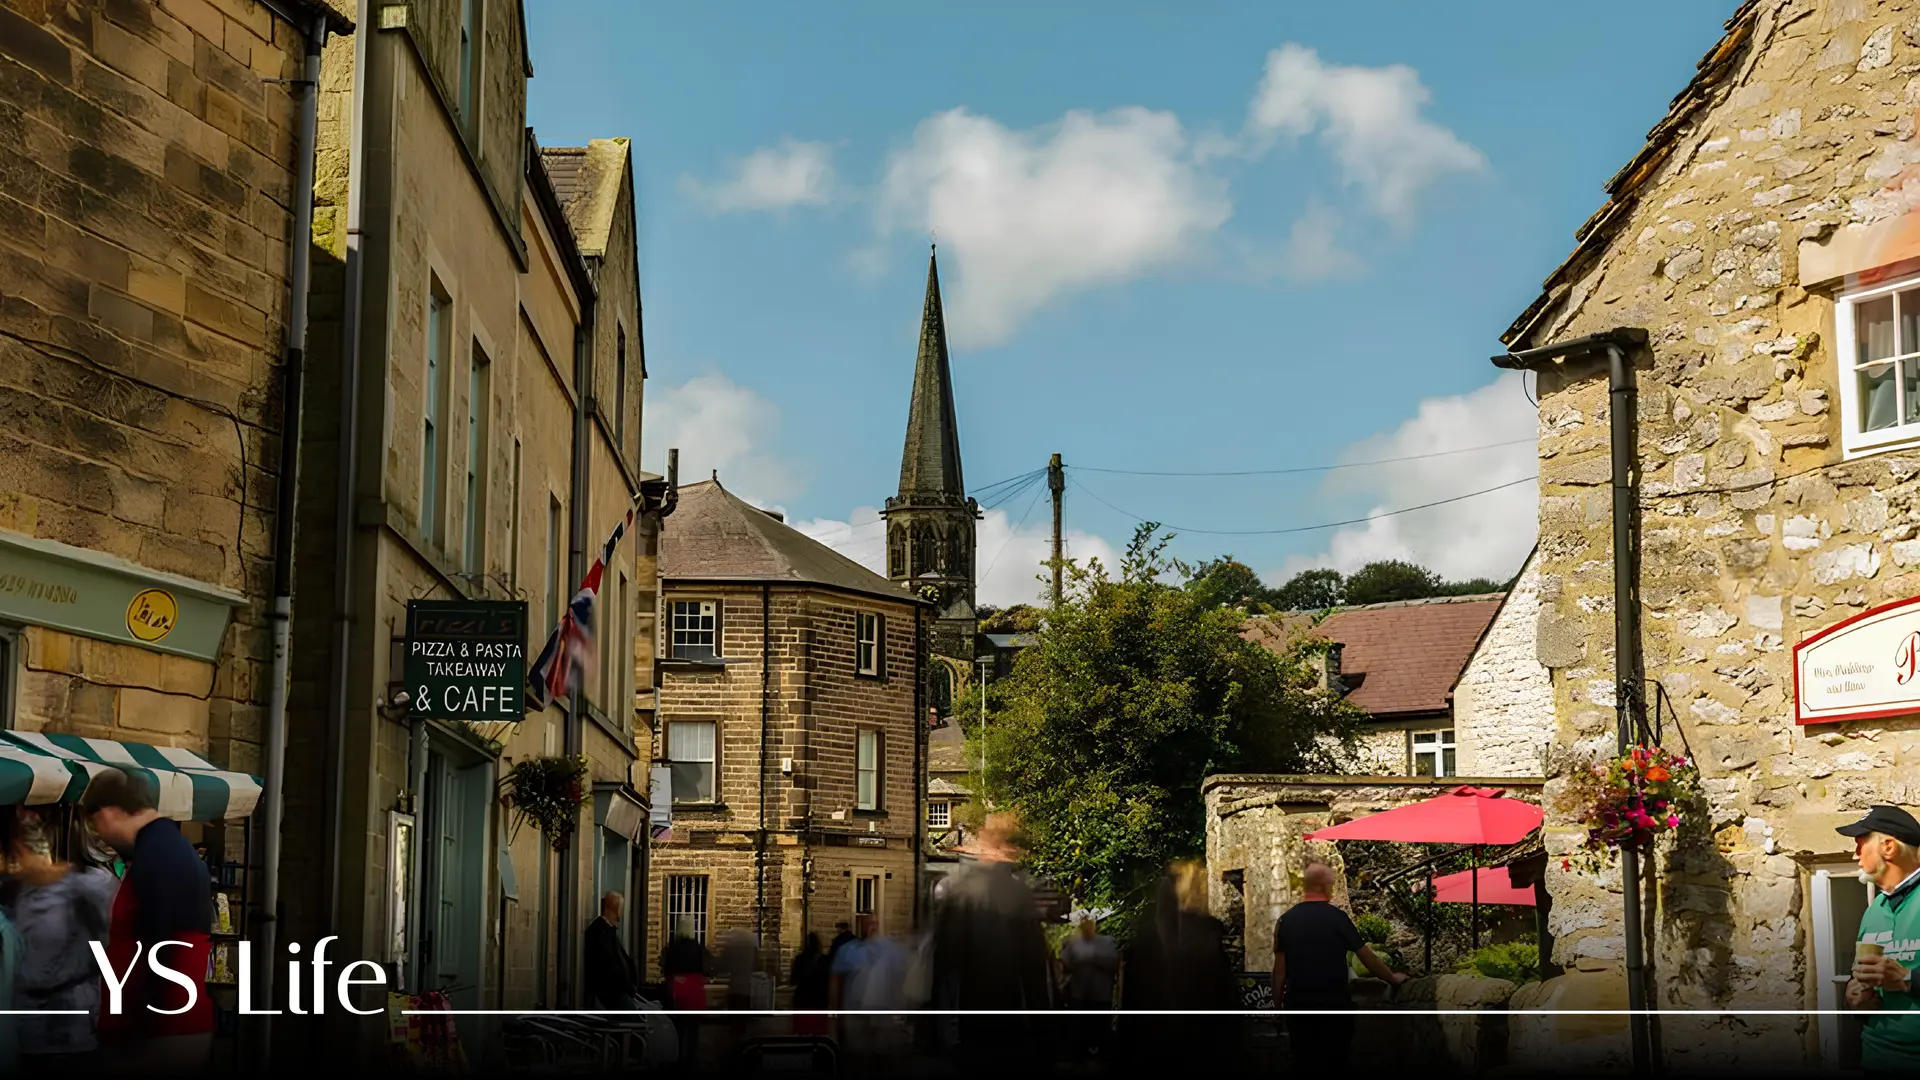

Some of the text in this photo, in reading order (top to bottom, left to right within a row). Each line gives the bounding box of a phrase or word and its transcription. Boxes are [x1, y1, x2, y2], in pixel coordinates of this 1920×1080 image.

[411, 641, 522, 658] PIZZA & PASTA
[426, 662, 506, 677] TAKEAWAY
[415, 684, 514, 713] & CAFE
